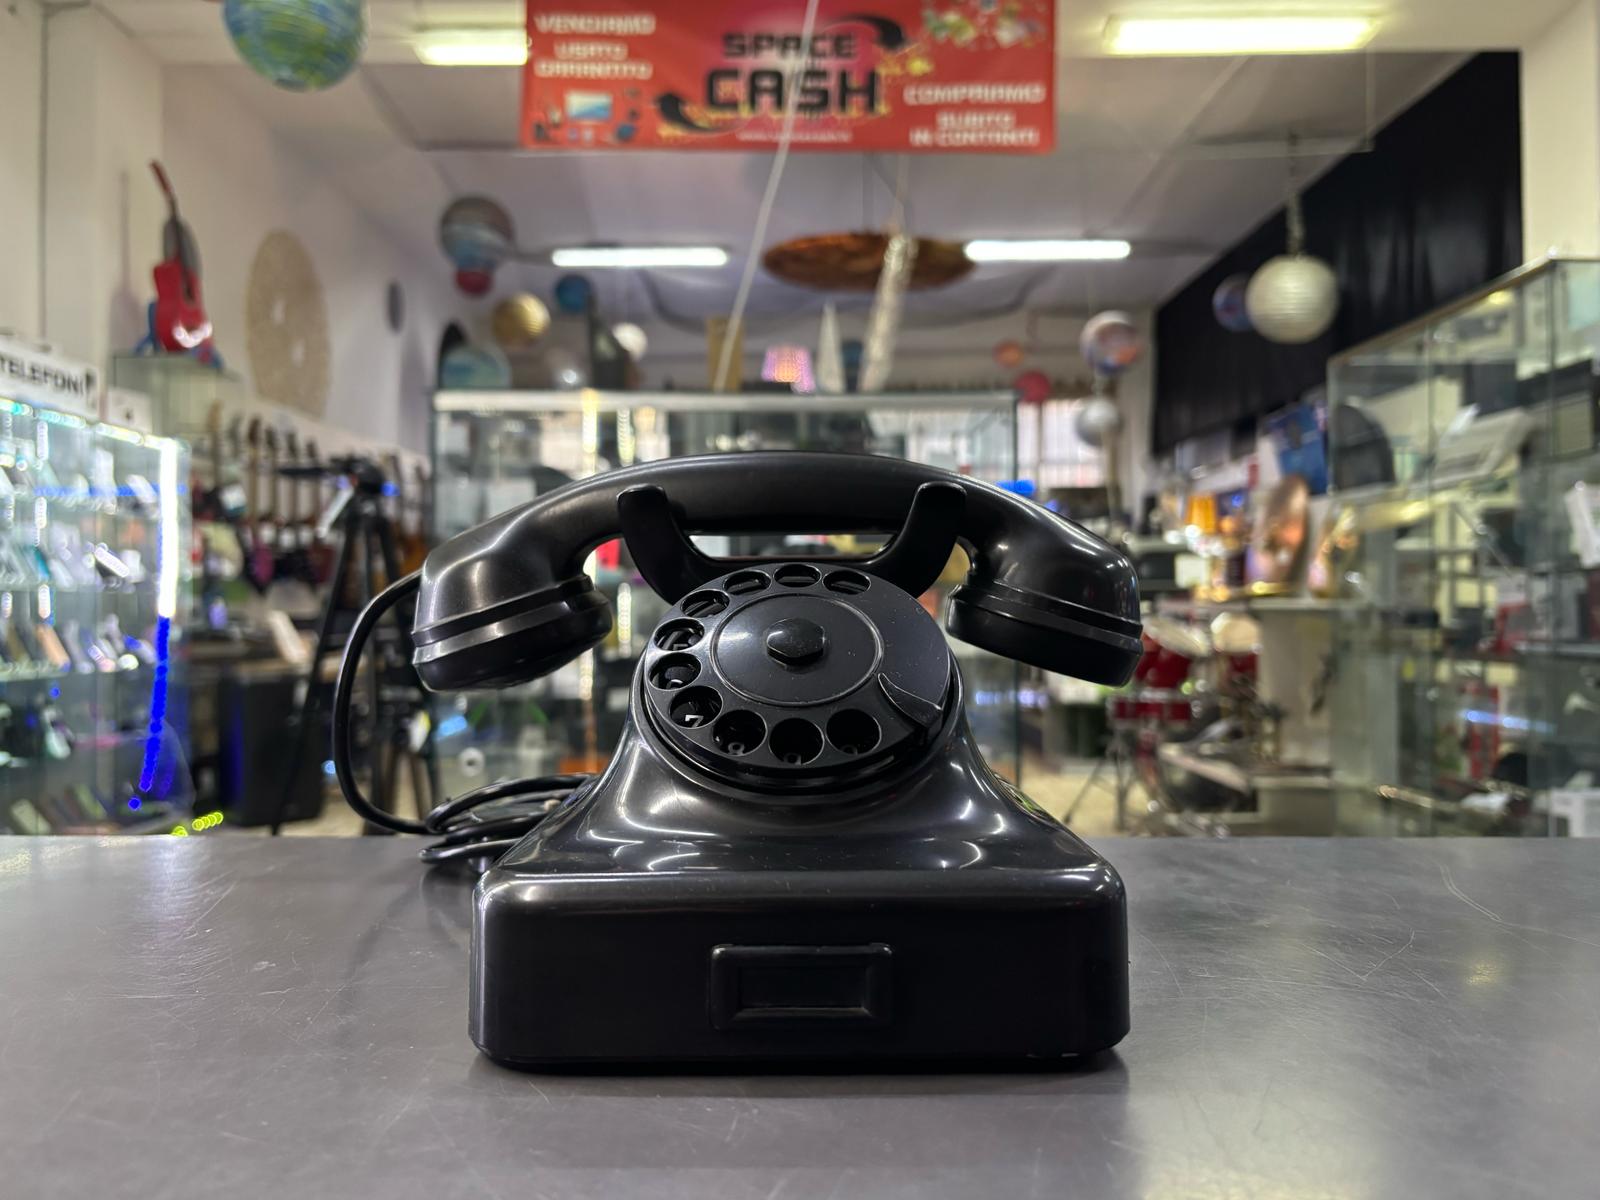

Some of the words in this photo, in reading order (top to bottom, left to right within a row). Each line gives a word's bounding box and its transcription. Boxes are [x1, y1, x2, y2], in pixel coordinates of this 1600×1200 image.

[723, 34, 855, 59] SPACE
[707, 67, 880, 114] CASH
[903, 83, 1047, 105] COMPRIAMO
